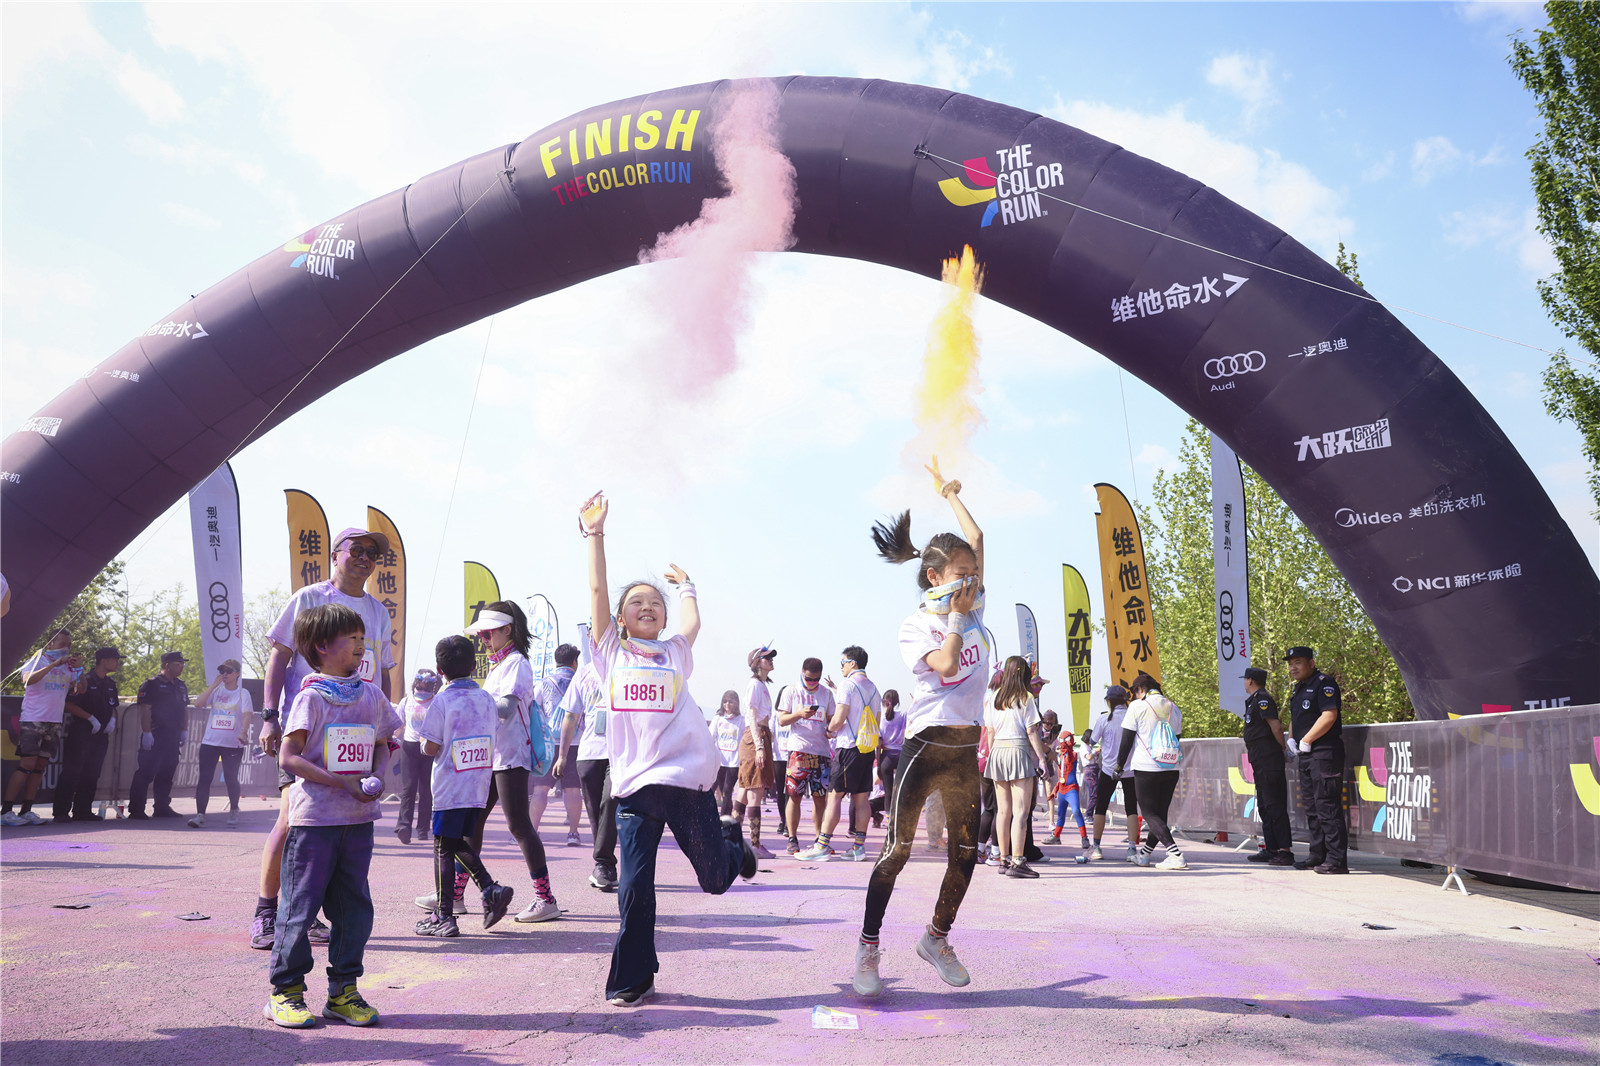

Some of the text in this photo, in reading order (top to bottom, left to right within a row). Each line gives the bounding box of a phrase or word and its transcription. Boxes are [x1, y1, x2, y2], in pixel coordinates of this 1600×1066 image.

[539, 109, 701, 179] FINISH
[996, 143, 1033, 172] THE
[997, 162, 1065, 198] COLOR
[1000, 193, 1042, 226] RUN
[318, 222, 345, 239] THE
[310, 238, 355, 260] COLOR
[1110, 275, 1222, 323] 维他命水
[1210, 381, 1236, 392] Audi
[1294, 427, 1354, 461] 大跃
[1335, 493, 1486, 527] Midea 美的洗衣机
[1417, 562, 1522, 590] NCI 新华保险
[959, 644, 980, 671] 427
[1239, 629, 1247, 658] Audi
[623, 684, 664, 702] 19851
[337, 743, 373, 762] 2997
[1389, 741, 1413, 773] THE
[1387, 774, 1431, 809] COLOR
